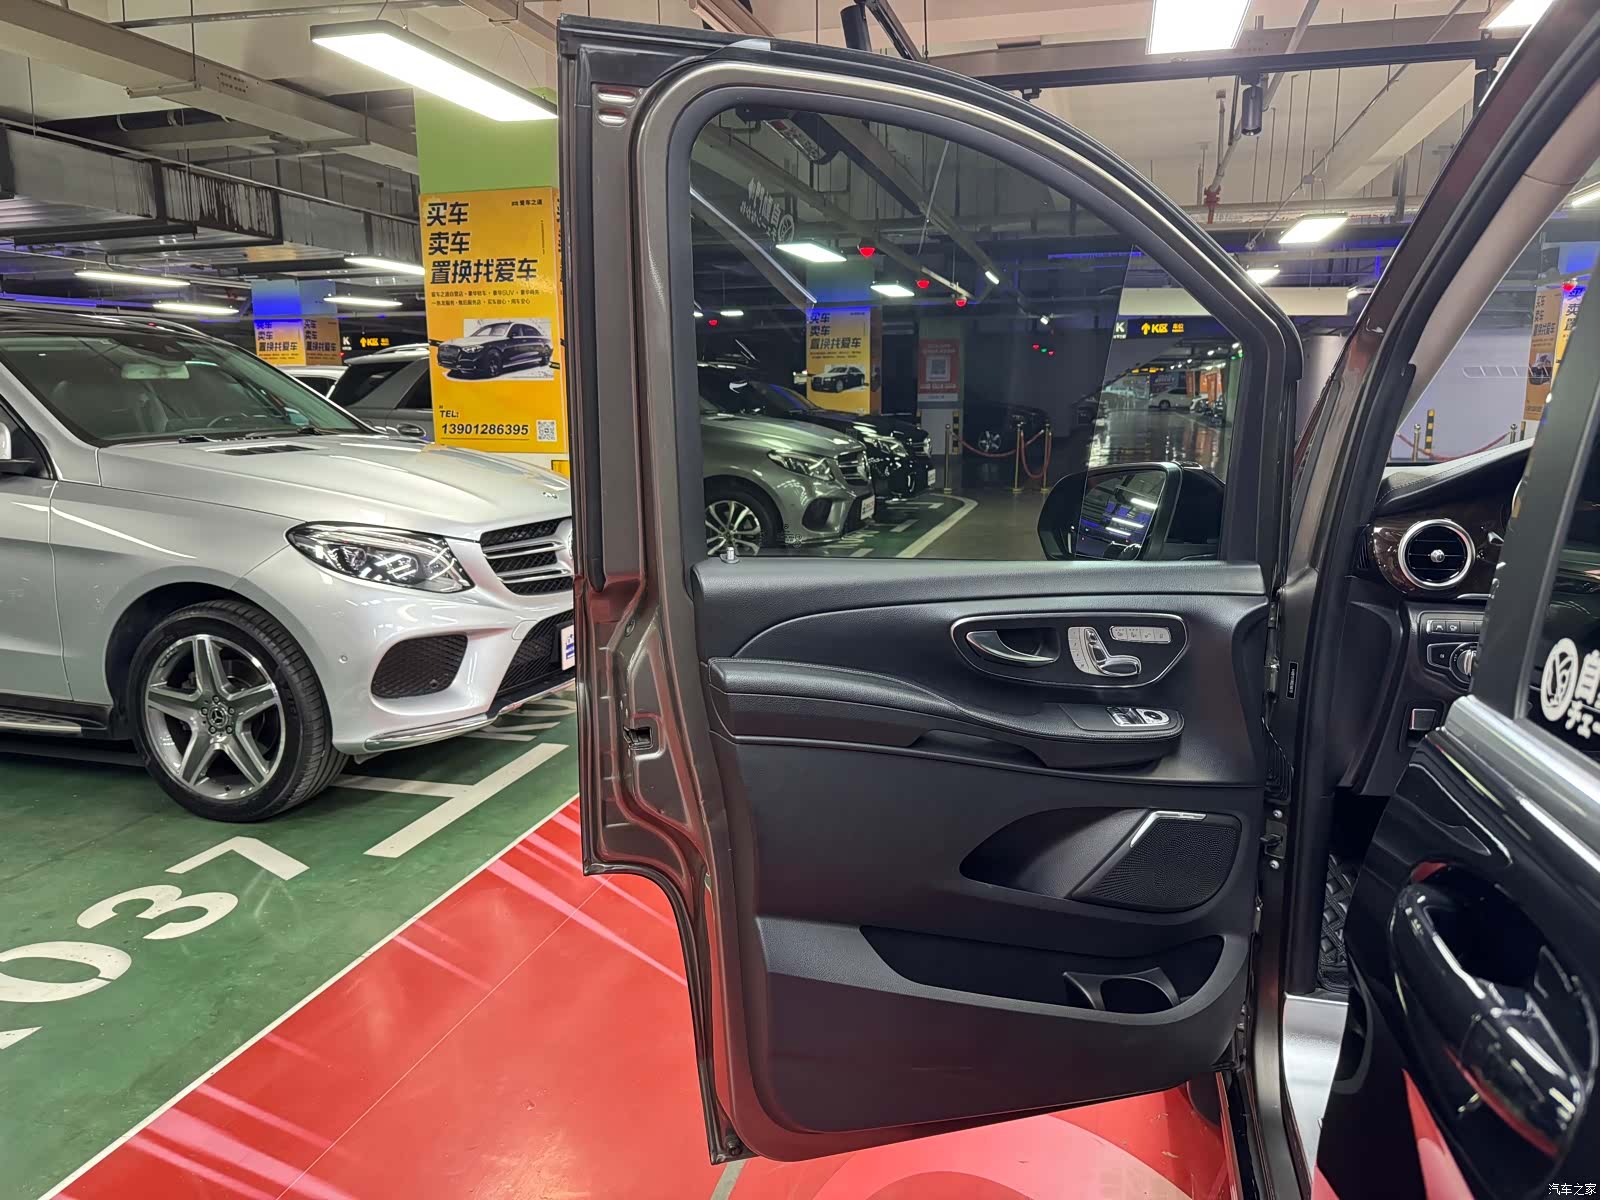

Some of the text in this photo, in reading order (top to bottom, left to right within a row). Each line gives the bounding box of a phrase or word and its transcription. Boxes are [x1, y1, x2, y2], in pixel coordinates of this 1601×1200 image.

[427, 202, 470, 226] 买车
[429, 231, 471, 256] 卖车
[431, 257, 539, 285] 置换找爱车
[1115, 322, 1125, 332] K
[342, 336, 350, 345] K
[440, 410, 459, 418] TEL:
[441, 424, 528, 435] 13901286395
[0, 836, 311, 1050] 037
